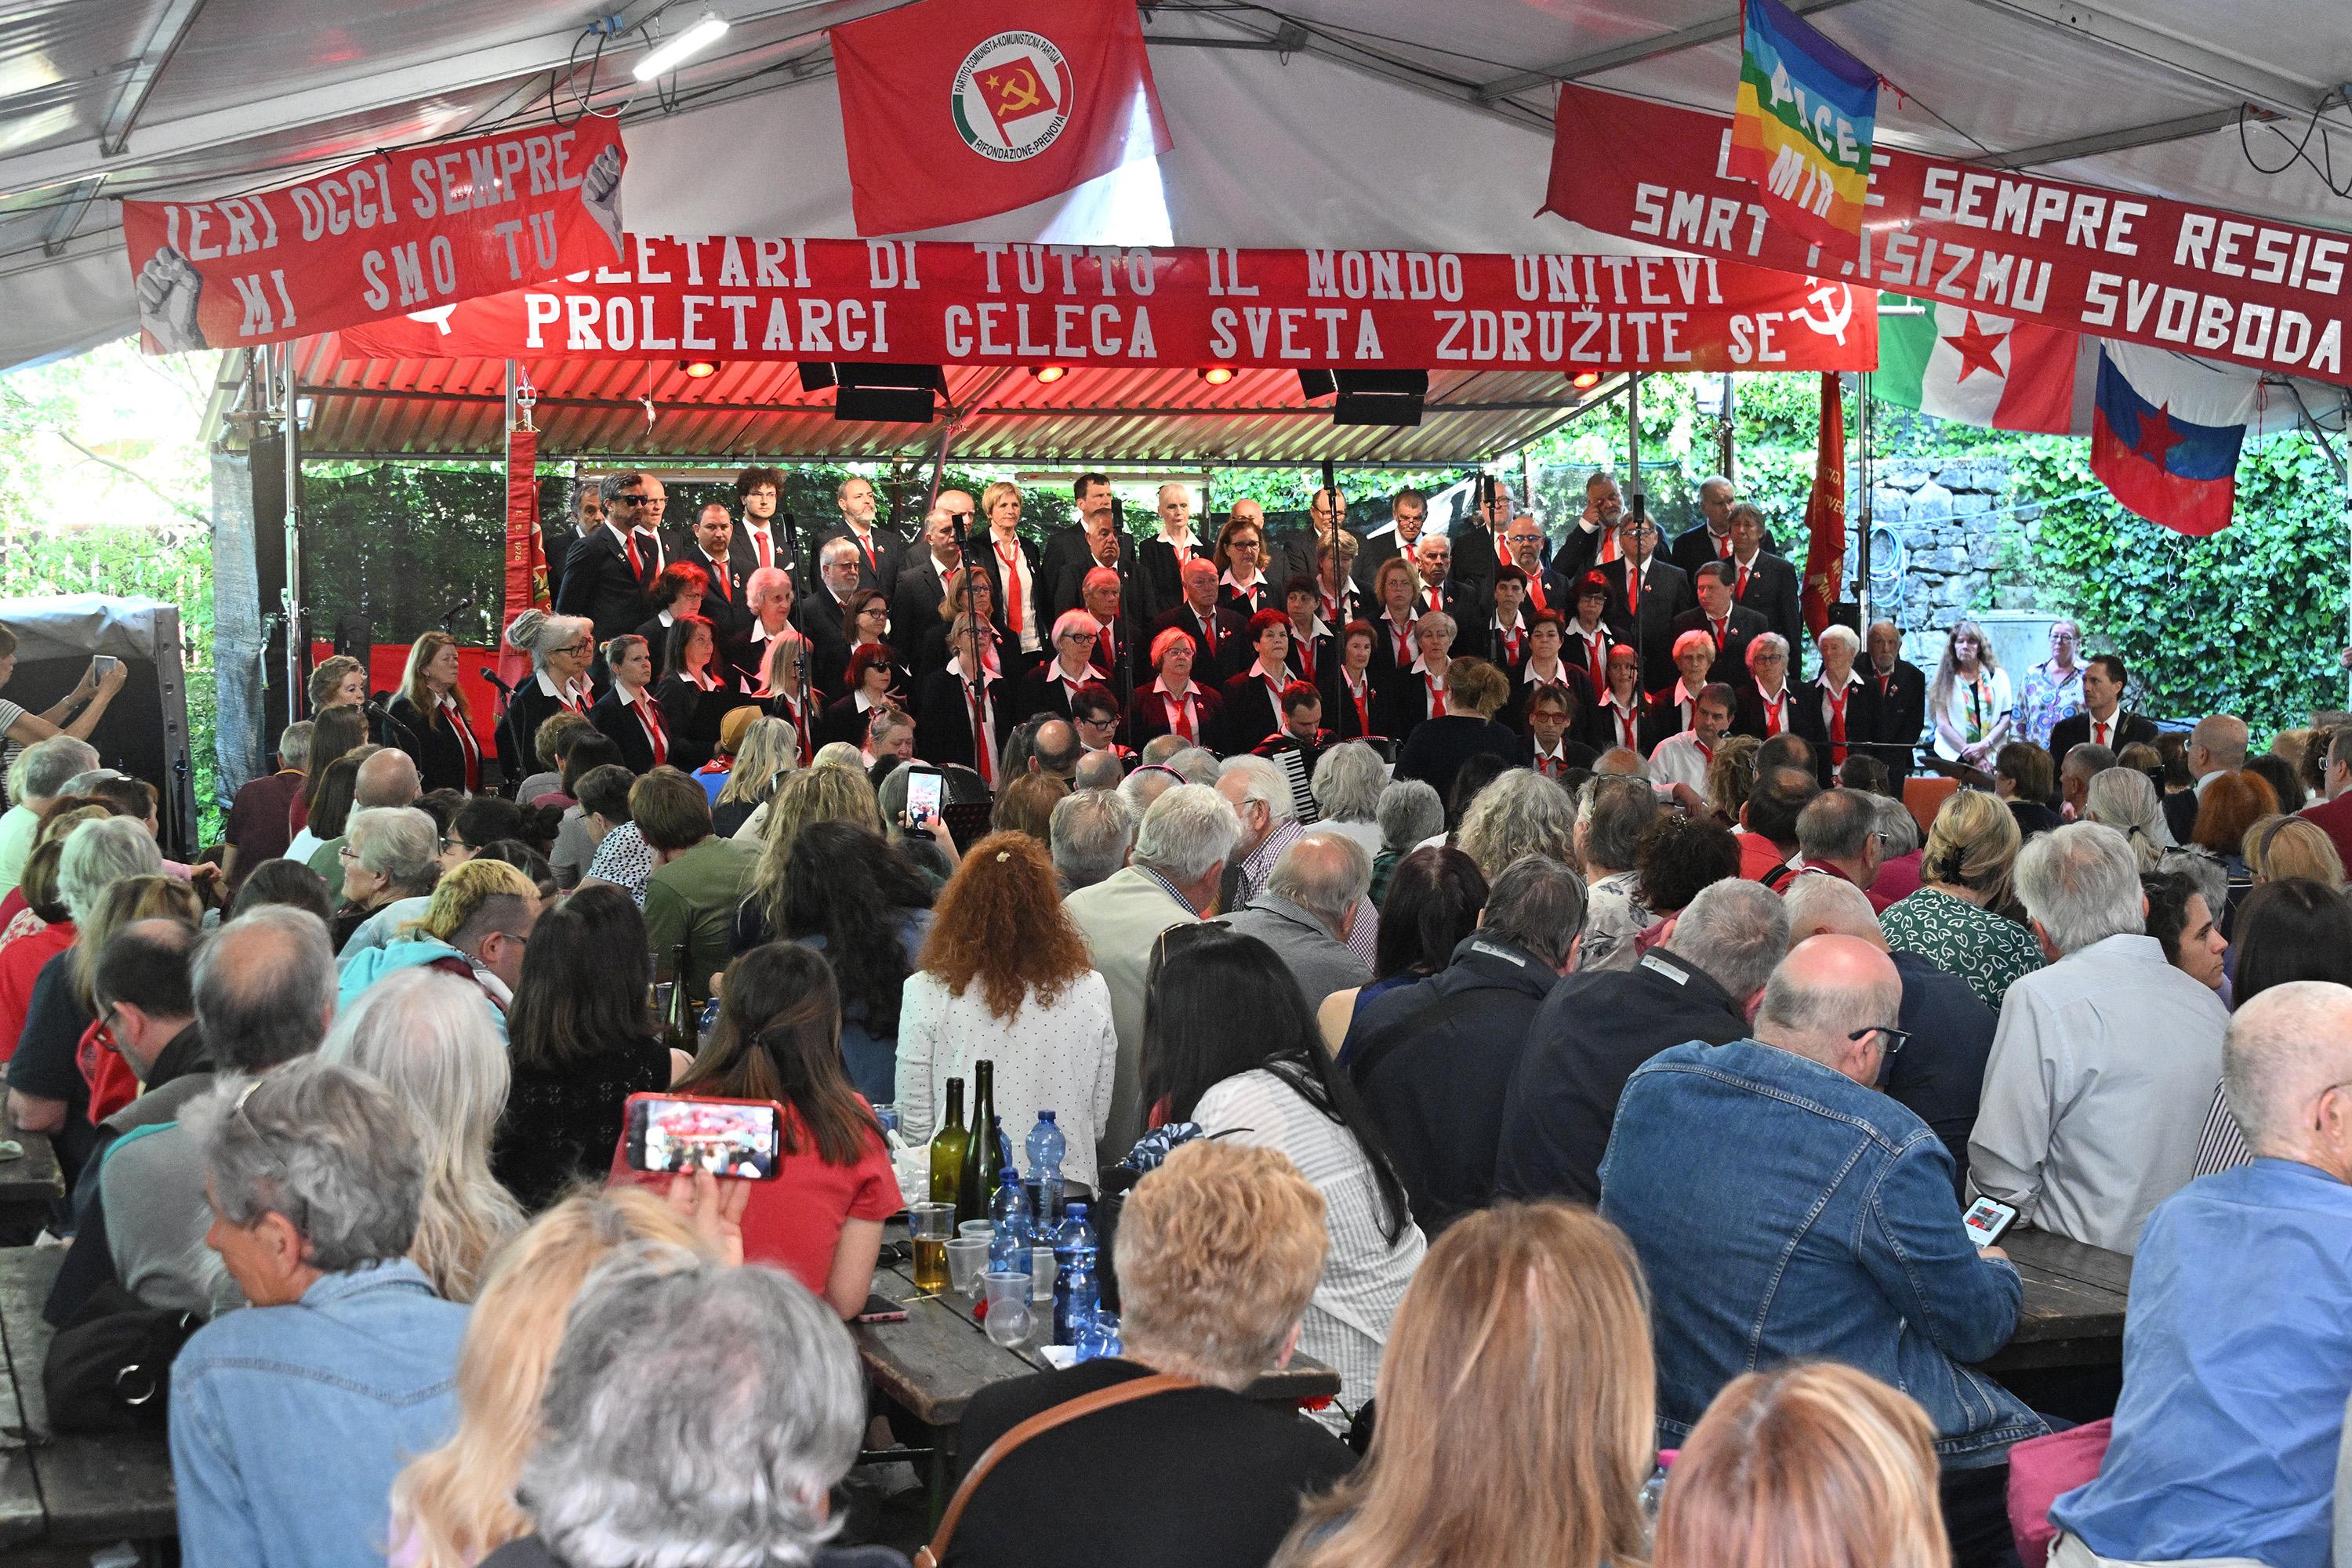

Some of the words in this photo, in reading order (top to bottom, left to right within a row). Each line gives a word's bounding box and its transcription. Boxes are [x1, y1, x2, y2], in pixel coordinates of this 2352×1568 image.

[955, 66, 972, 93] PARTITO
[1039, 42, 1061, 64] PARTIJA
[1769, 60, 1860, 164] PACE
[164, 195, 278, 262] IERI
[291, 163, 397, 242] OGGI
[411, 131, 583, 219] SEMPRE
[1767, 143, 1835, 220] MIR
[1918, 167, 2150, 257] SEMPRE
[2173, 212, 2350, 296] RESIS
[232, 269, 296, 336] MI
[362, 235, 456, 311] SMO
[495, 210, 557, 281] TU
[866, 239, 920, 289] DI
[974, 242, 1156, 297] TUTTO
[1206, 247, 1259, 296] IL
[1306, 249, 1463, 302] MONDO
[1511, 254, 1722, 305] UNITEVI
[1631, 182, 1771, 257] SMRT
[1806, 218, 2053, 314] ŠIZMU
[2082, 270, 2342, 375] SVOBODA
[1210, 307, 1384, 360] SVETA
[1434, 303, 1692, 364] ZDRUŽITE
[1729, 313, 1786, 364] SE
